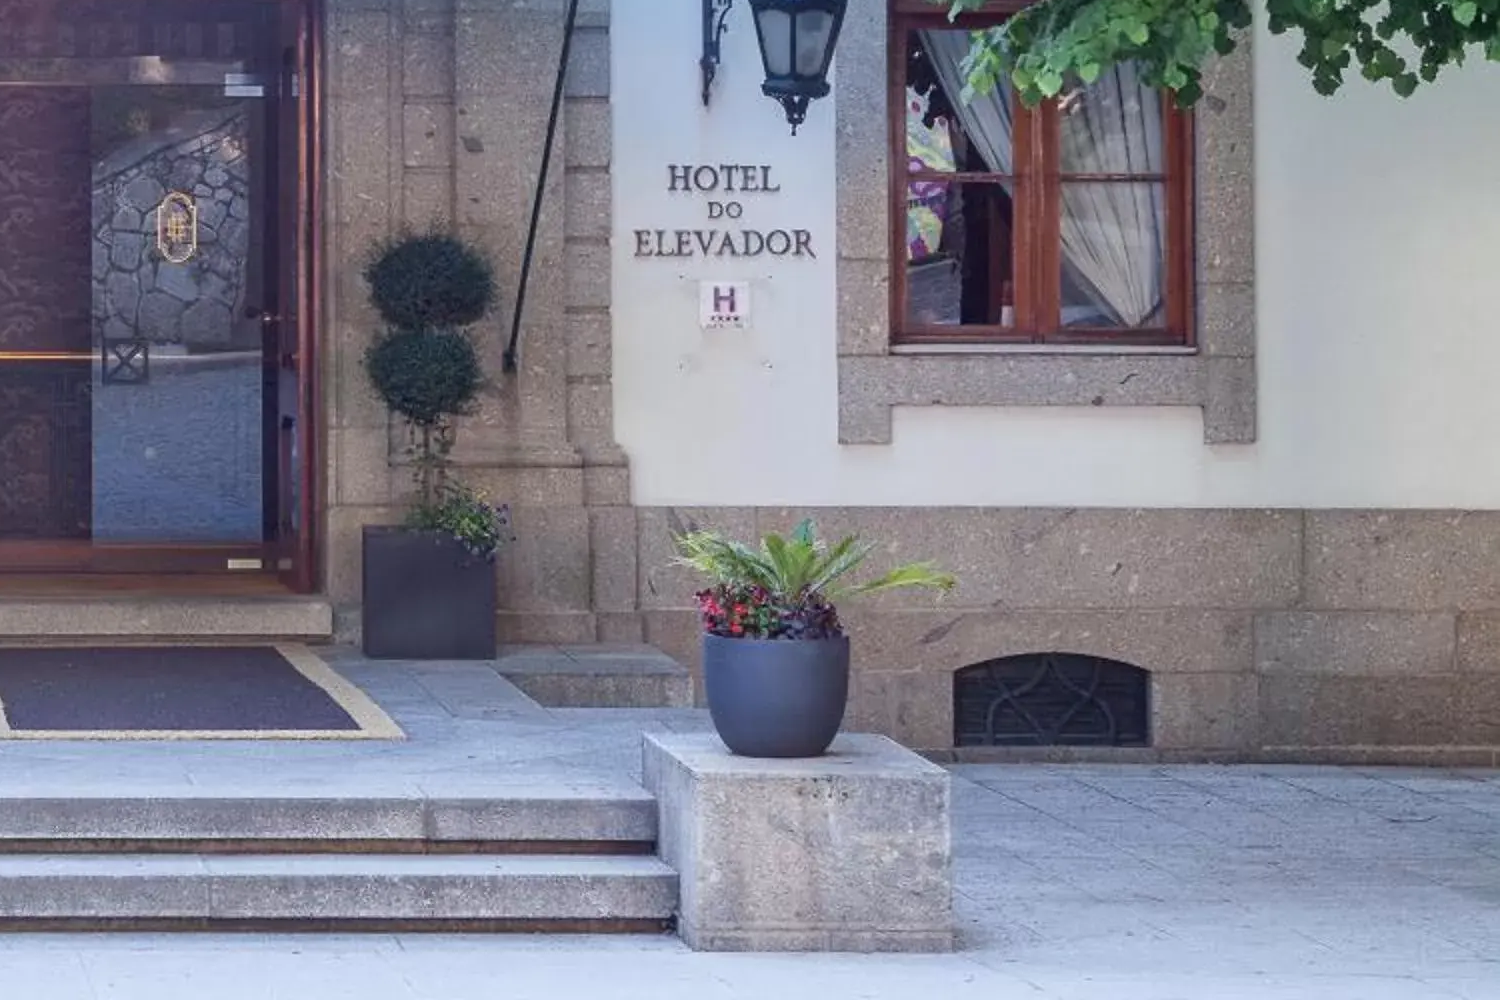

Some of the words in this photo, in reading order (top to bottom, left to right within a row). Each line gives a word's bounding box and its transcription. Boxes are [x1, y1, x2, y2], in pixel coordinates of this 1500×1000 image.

[667, 164, 781, 192] HOTEL
[707, 201, 743, 219] DO
[633, 228, 817, 259] ELEVADOR
[713, 286, 736, 313] H
